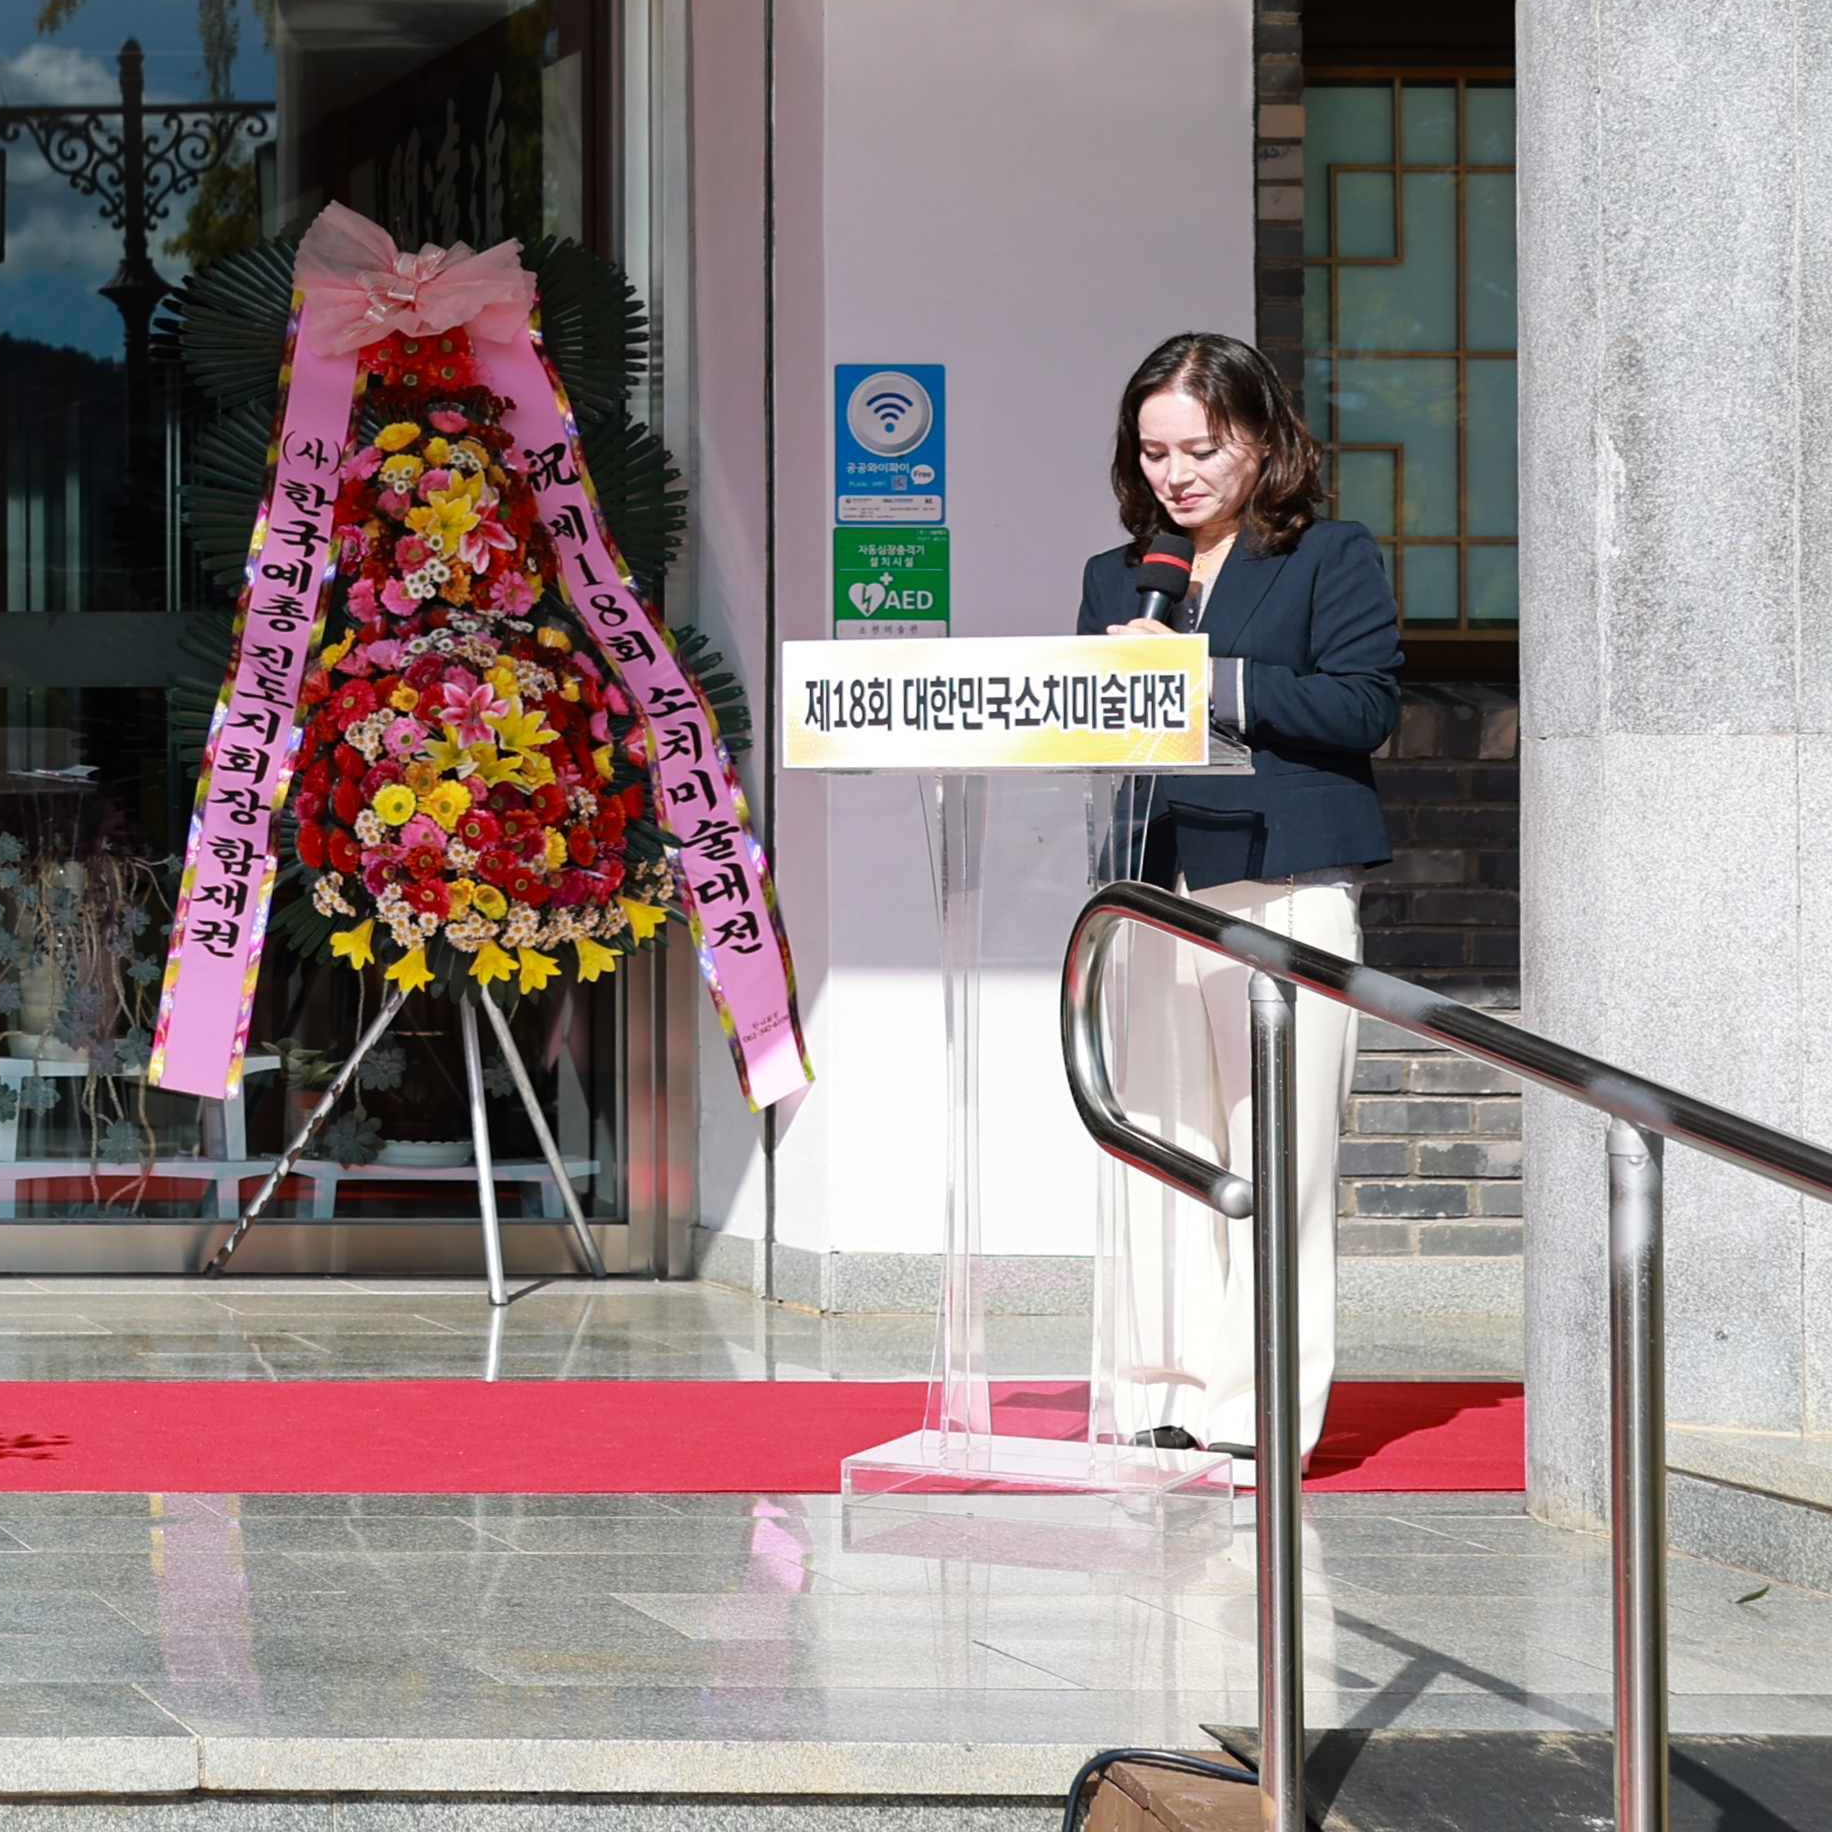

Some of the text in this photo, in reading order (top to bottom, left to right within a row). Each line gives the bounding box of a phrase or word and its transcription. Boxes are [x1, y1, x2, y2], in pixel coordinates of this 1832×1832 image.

[523, 442, 580, 492] 祝
[913, 470, 932, 478] Free
[884, 590, 934, 610] AED
[804, 672, 1187, 731] 제18회 대한민국소치미술대전
[547, 504, 764, 955] 제18회 소치미술대전
[191, 835, 266, 958] 함재권
